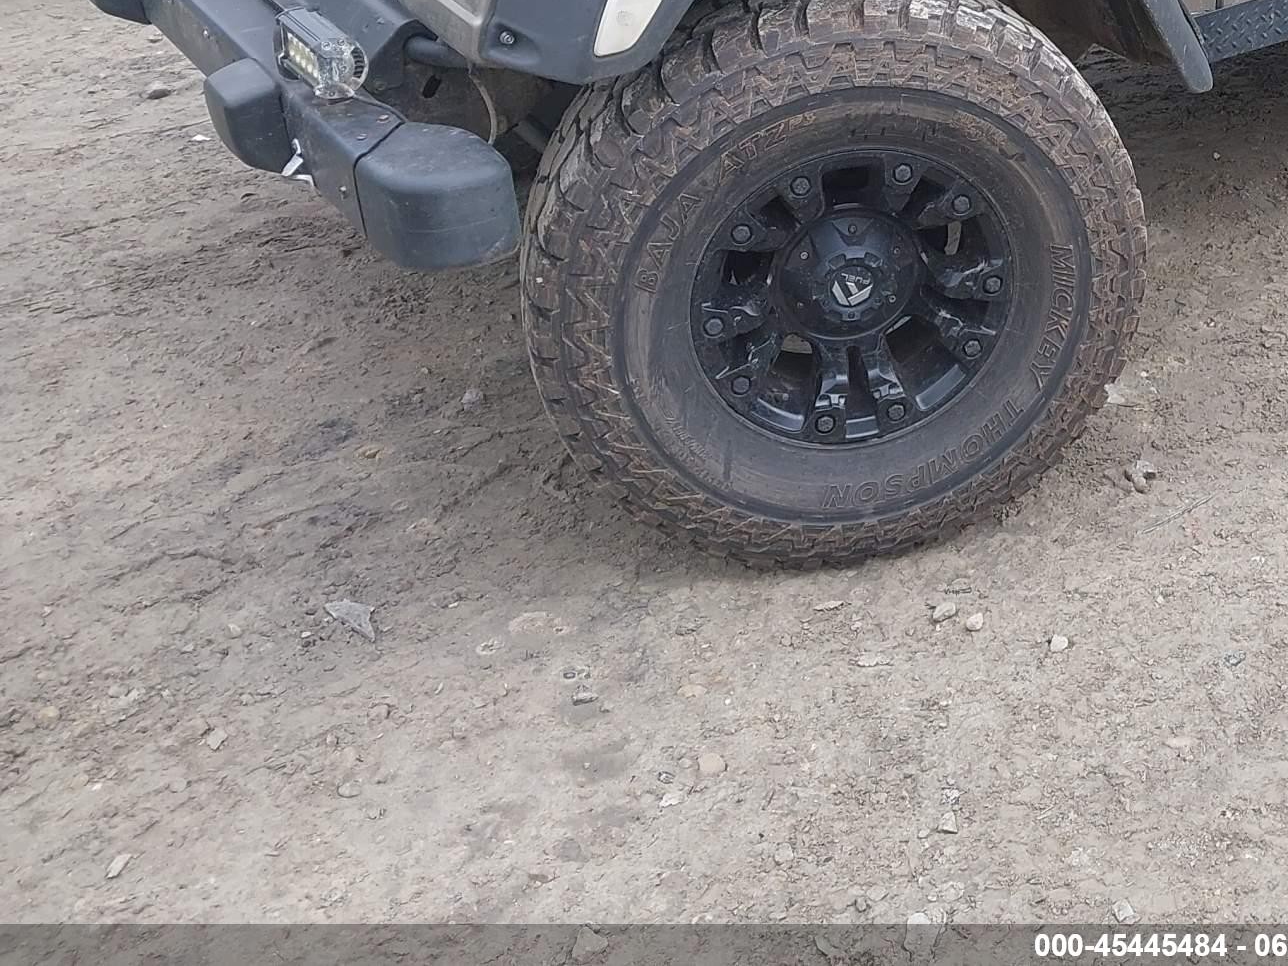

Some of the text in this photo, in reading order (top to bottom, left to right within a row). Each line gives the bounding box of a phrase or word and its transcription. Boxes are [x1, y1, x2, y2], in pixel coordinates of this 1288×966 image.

[634, 192, 703, 294] BAJA
[841, 272, 872, 285] FUEL
[822, 243, 1077, 509] MICKEY THOMPSON
